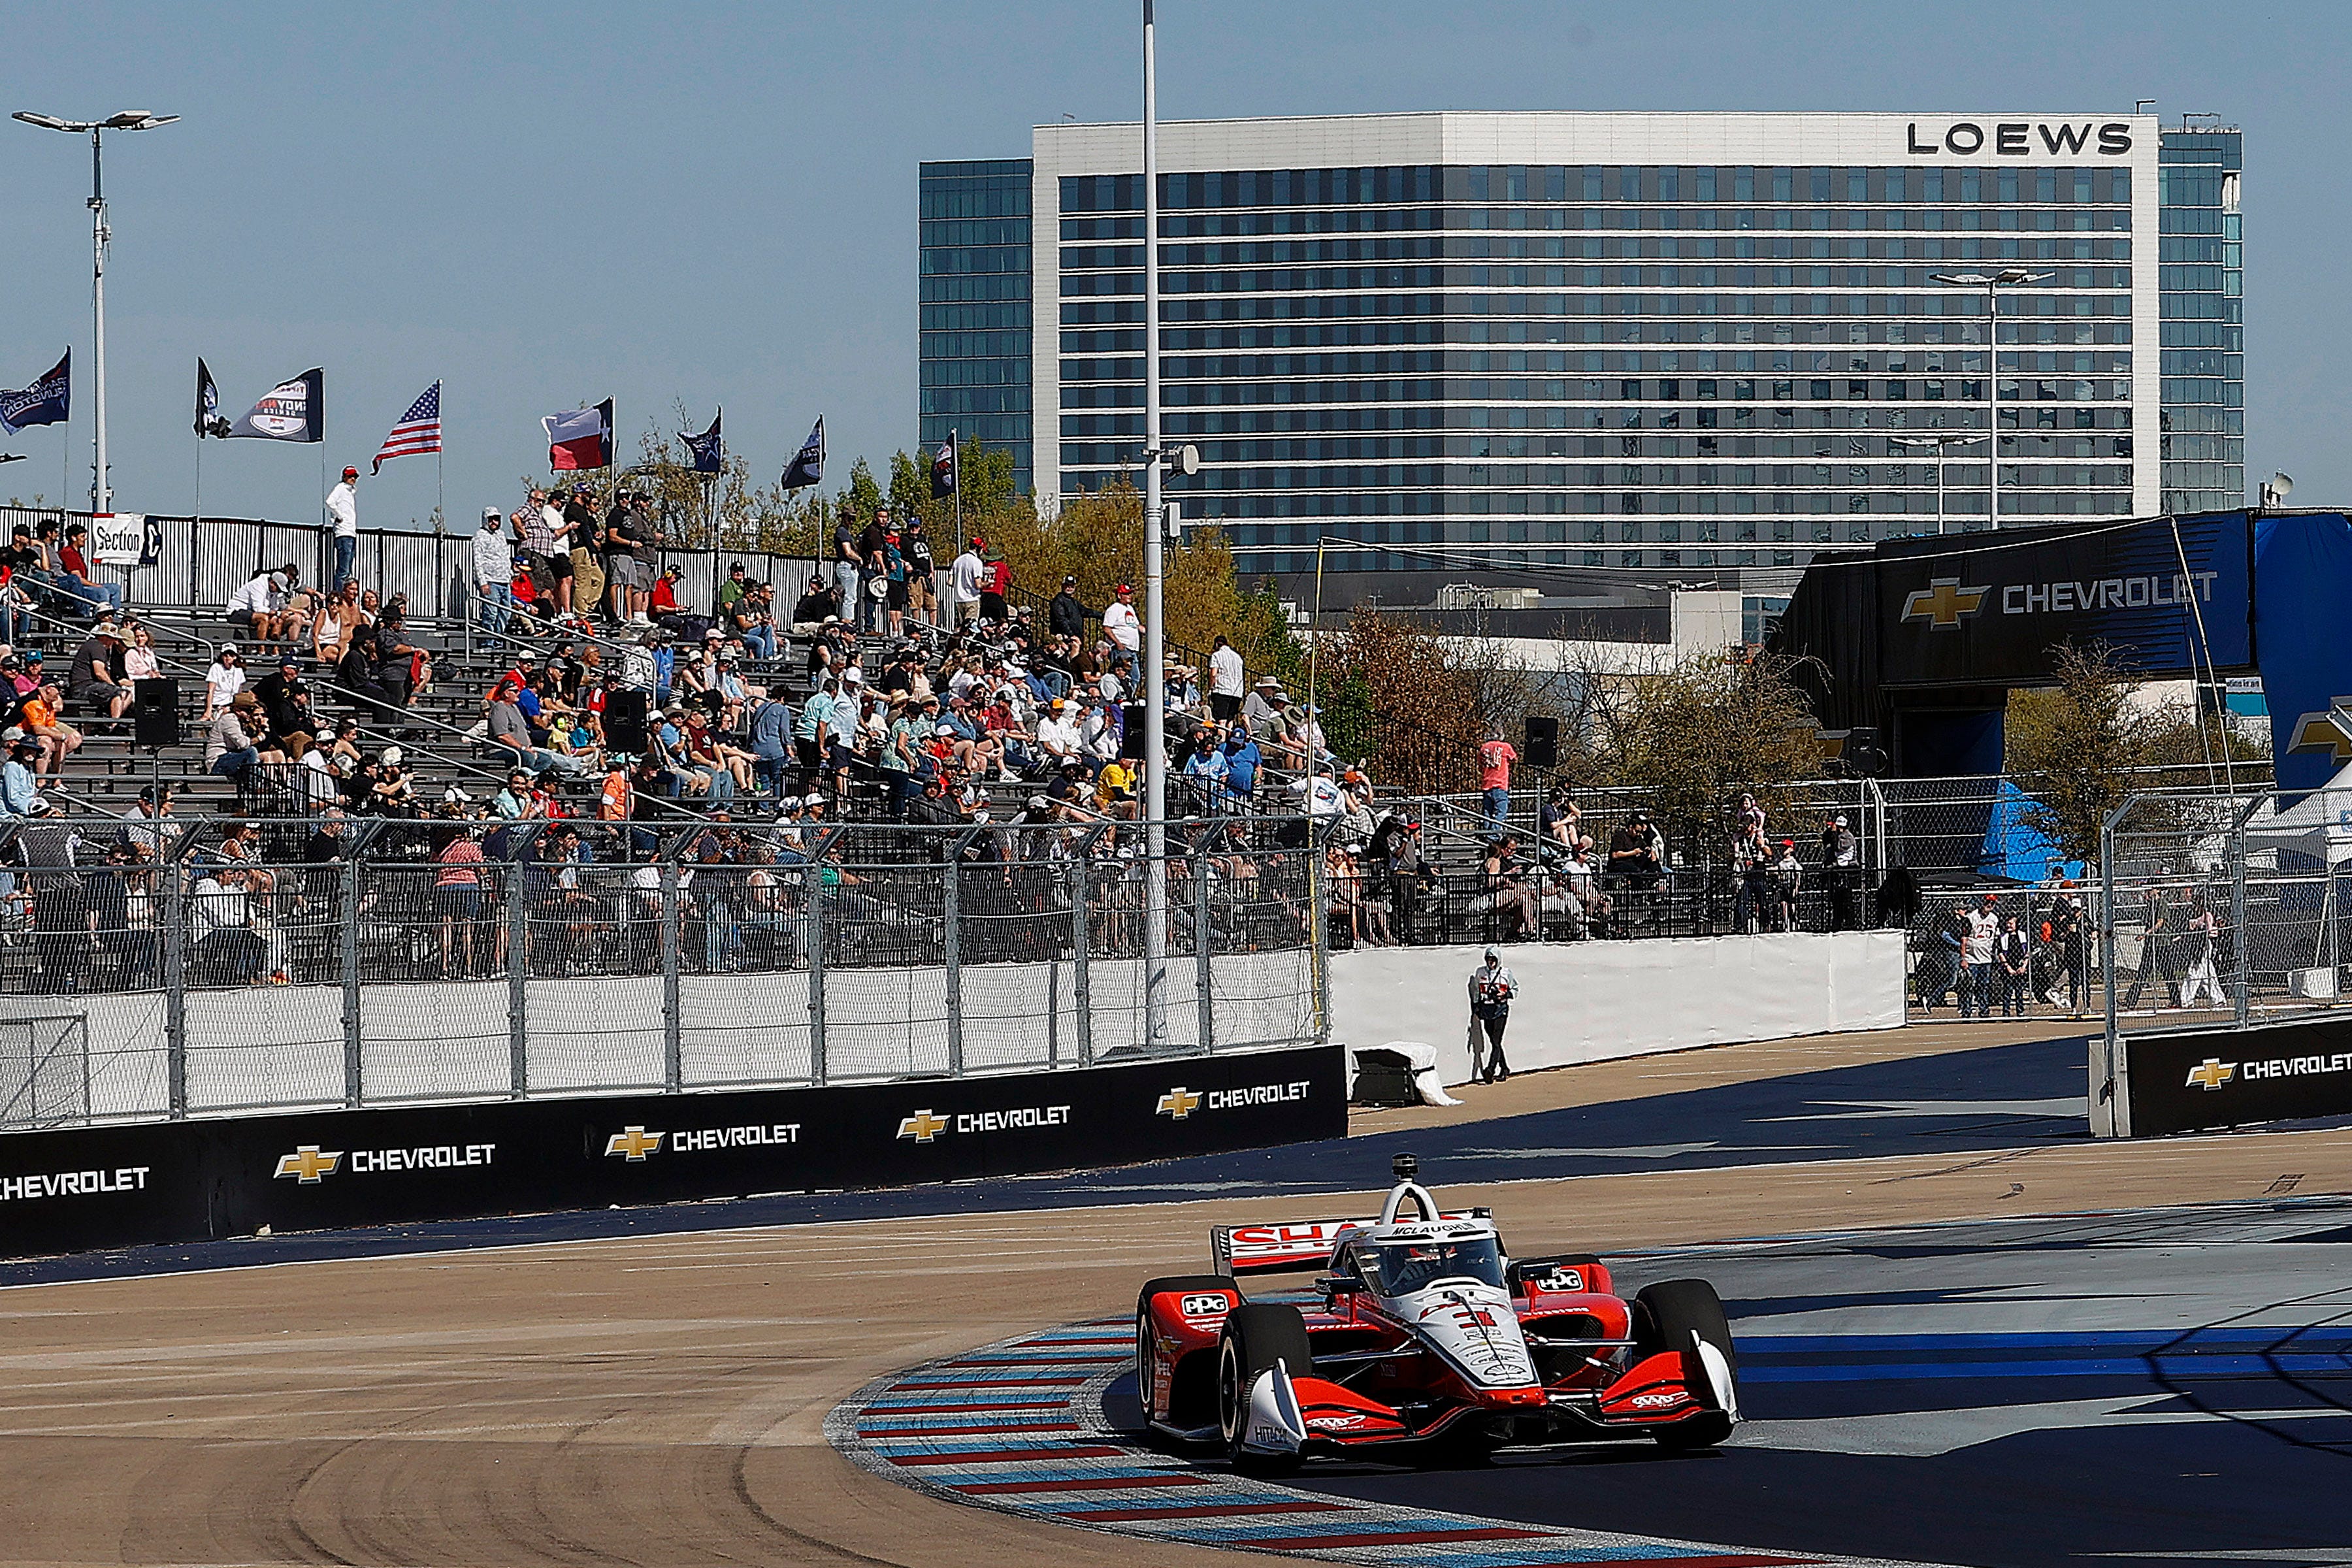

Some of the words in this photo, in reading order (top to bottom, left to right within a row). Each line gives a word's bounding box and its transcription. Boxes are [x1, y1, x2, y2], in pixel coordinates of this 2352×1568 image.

[1908, 122, 2132, 155] LOEWS
[97, 526, 140, 551] Section
[148, 524, 159, 557] C
[2002, 571, 2218, 614] CHEVROLET
[2243, 1053, 2352, 1080] CHEVROLET
[1209, 1081, 1310, 1109] CHEVROLET
[957, 1105, 1071, 1134] CHEVROLET
[673, 1124, 800, 1152] CHEVROLET
[351, 1144, 496, 1172] CHEVROLET
[1392, 1222, 1477, 1235] MCLAUGHLIN
[1185, 1298, 1225, 1314] PPG
